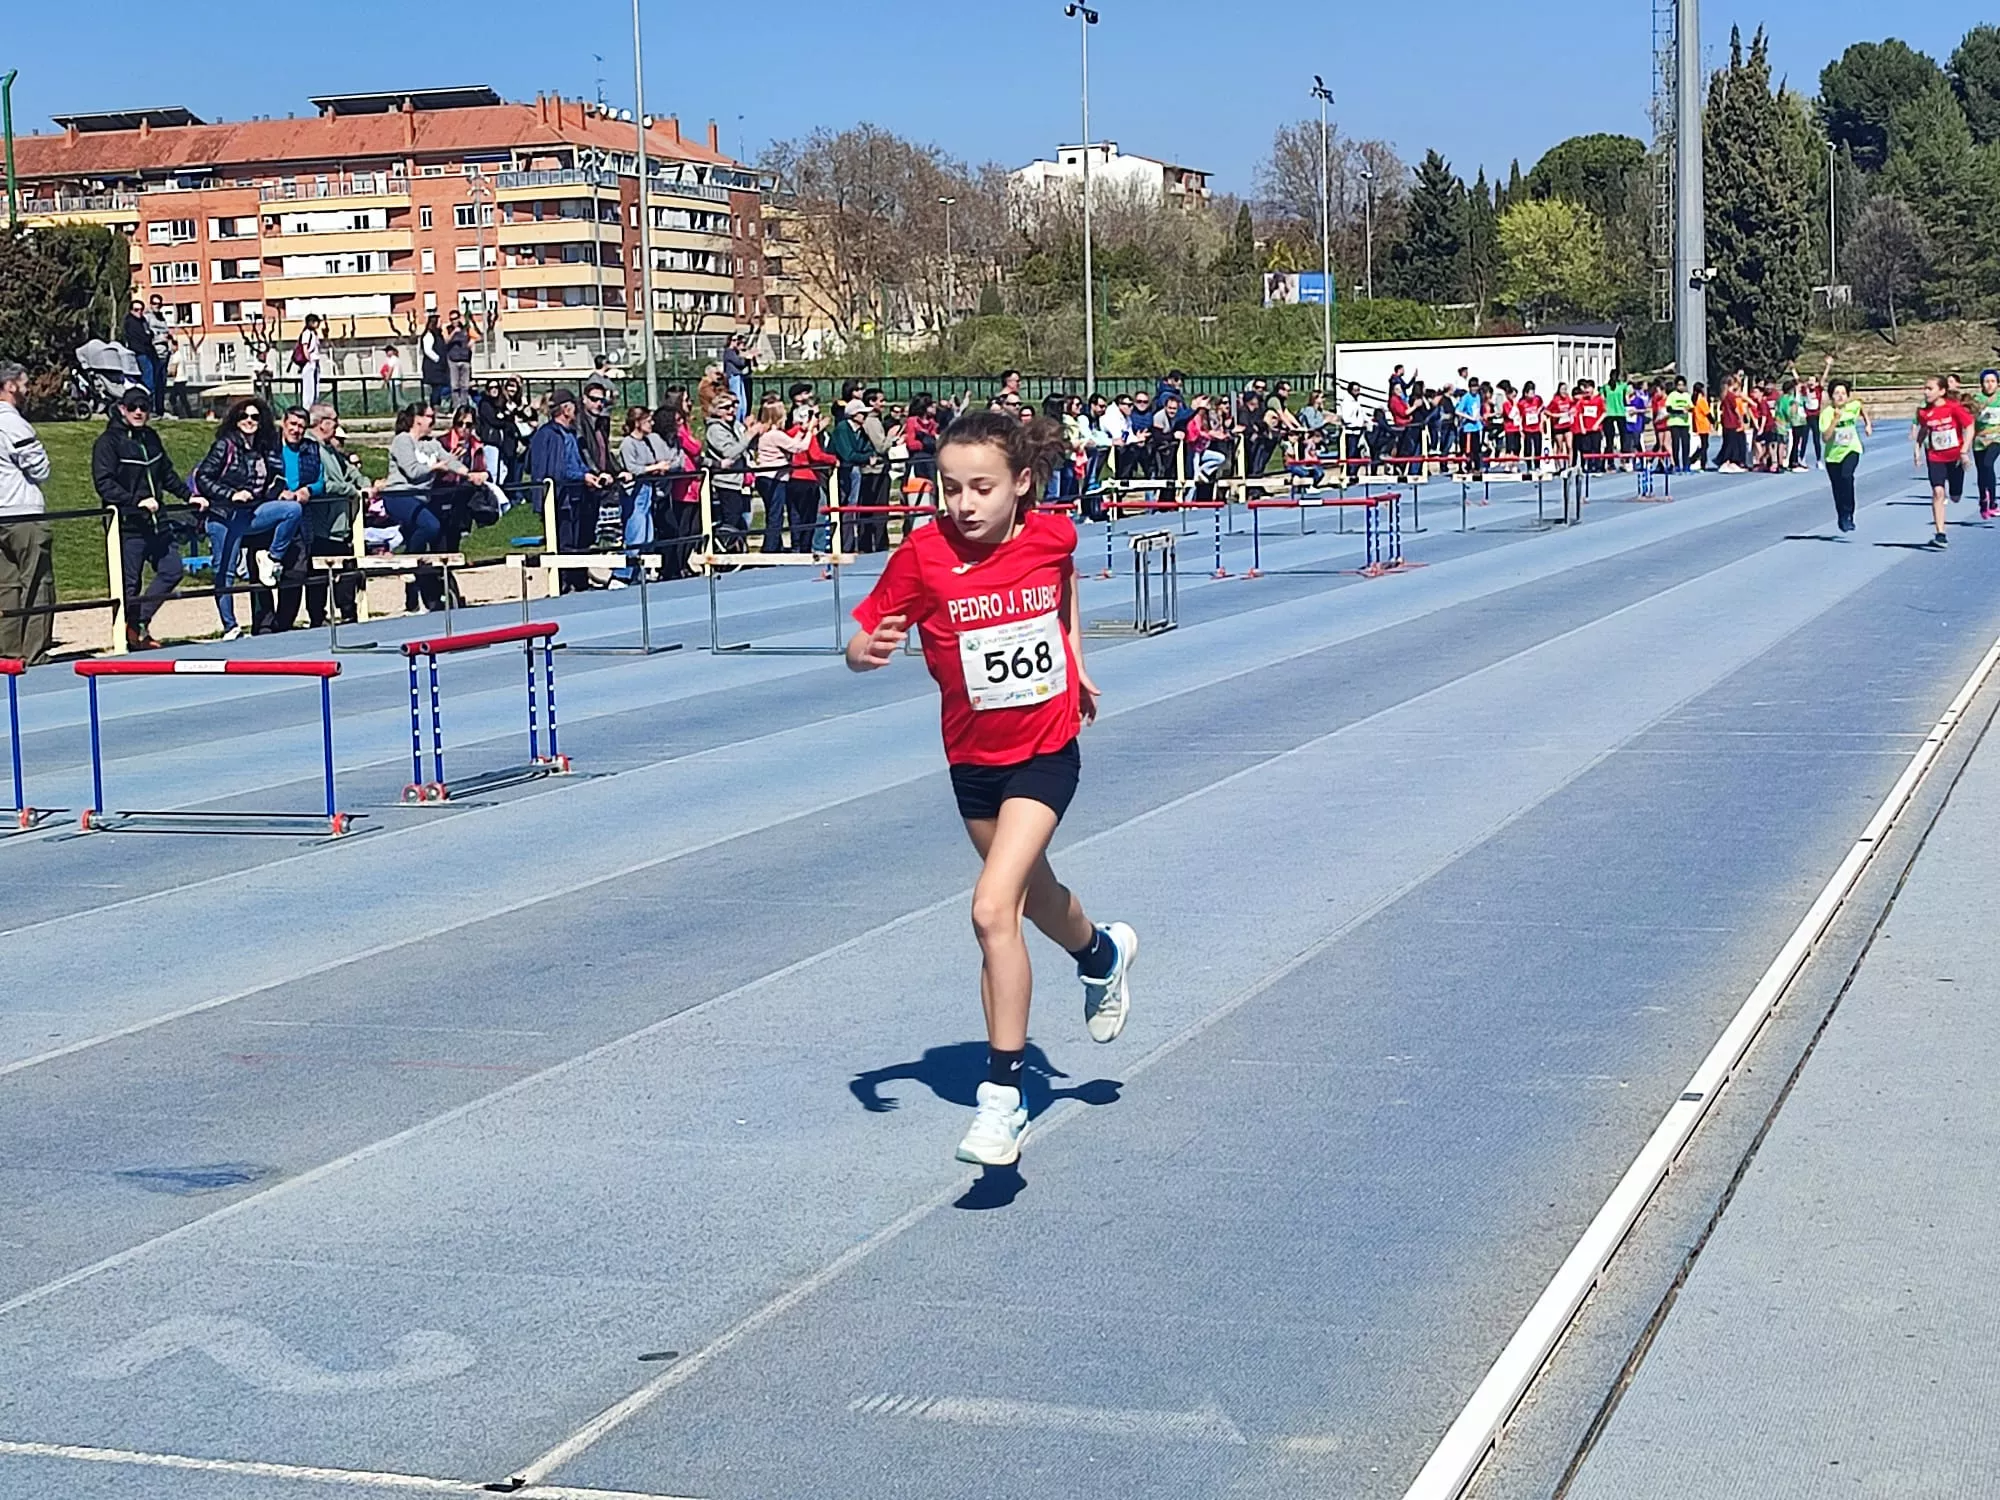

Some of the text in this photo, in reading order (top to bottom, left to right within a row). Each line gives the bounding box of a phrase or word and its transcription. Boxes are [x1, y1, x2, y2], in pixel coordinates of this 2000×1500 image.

[948, 593, 1003, 623] PEDRO
[1006, 590, 1020, 615] J.
[984, 640, 1053, 683] 568
